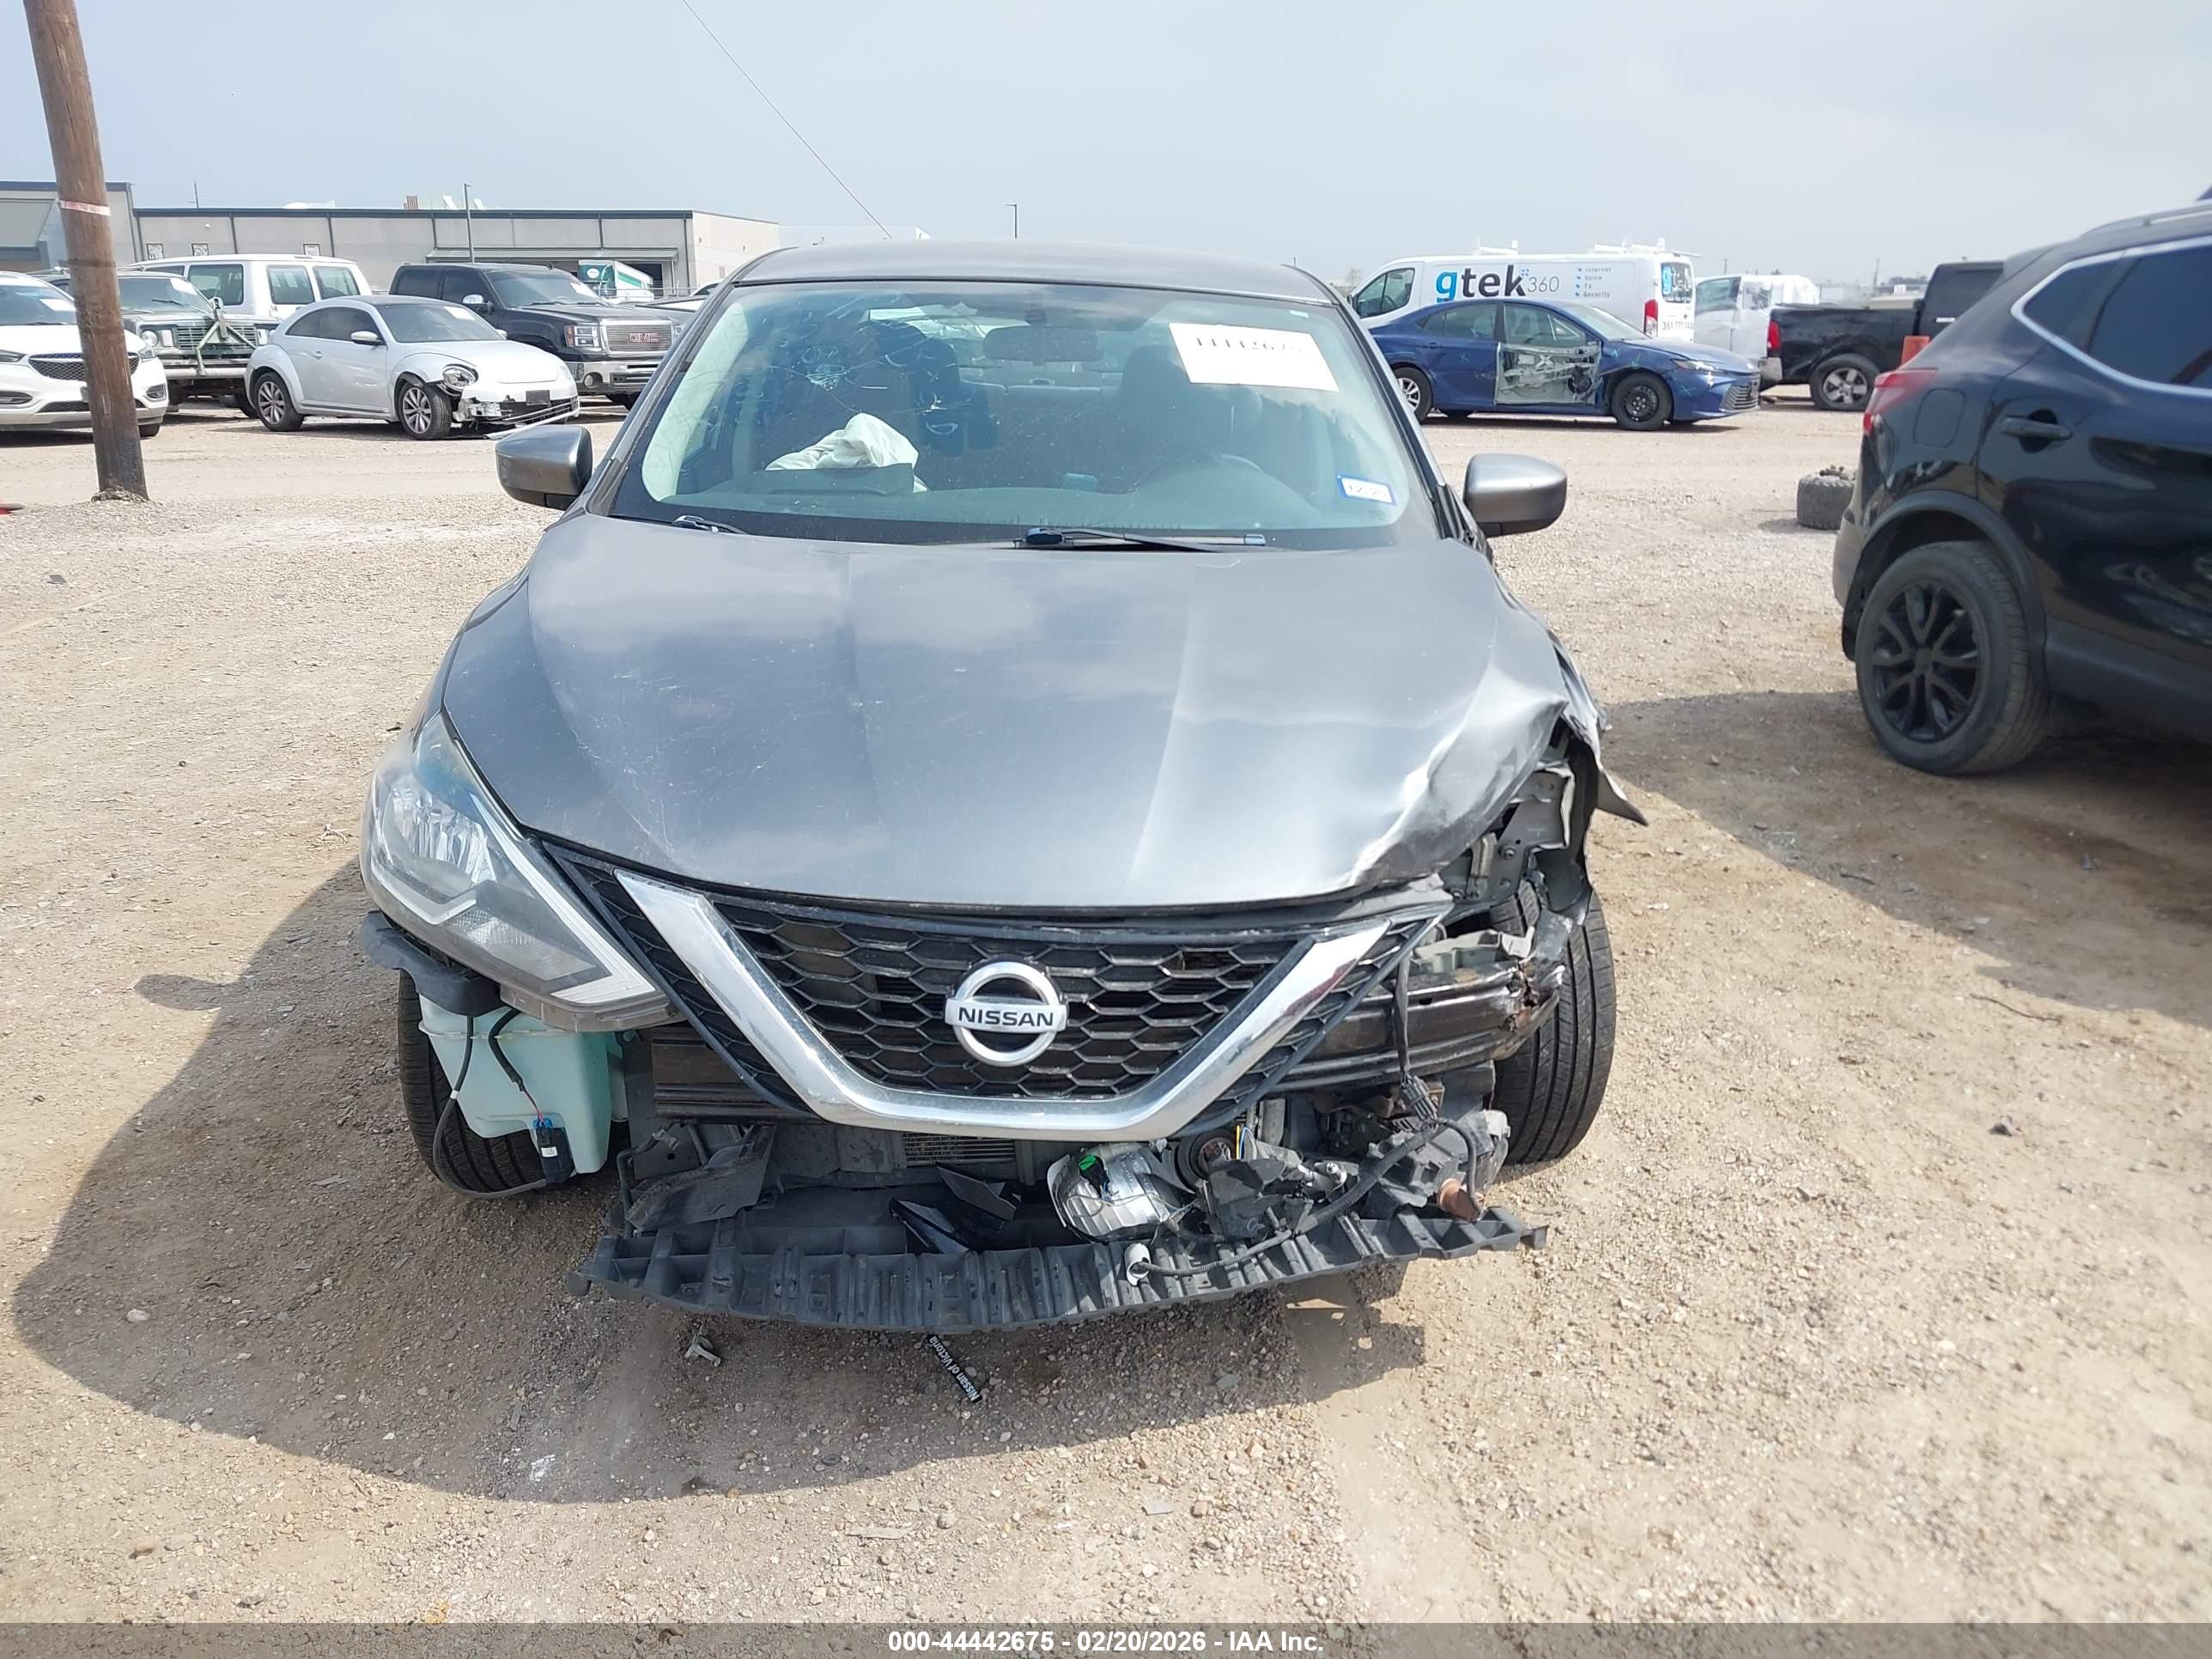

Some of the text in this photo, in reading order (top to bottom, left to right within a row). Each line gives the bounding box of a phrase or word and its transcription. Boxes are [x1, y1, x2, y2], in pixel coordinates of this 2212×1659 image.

[1435, 264, 1559, 303] gtek 360
[629, 332, 660, 343] GMC
[957, 1006, 1054, 1028] NISSAN
[929, 1335, 981, 1402] Nissan of Victoria
